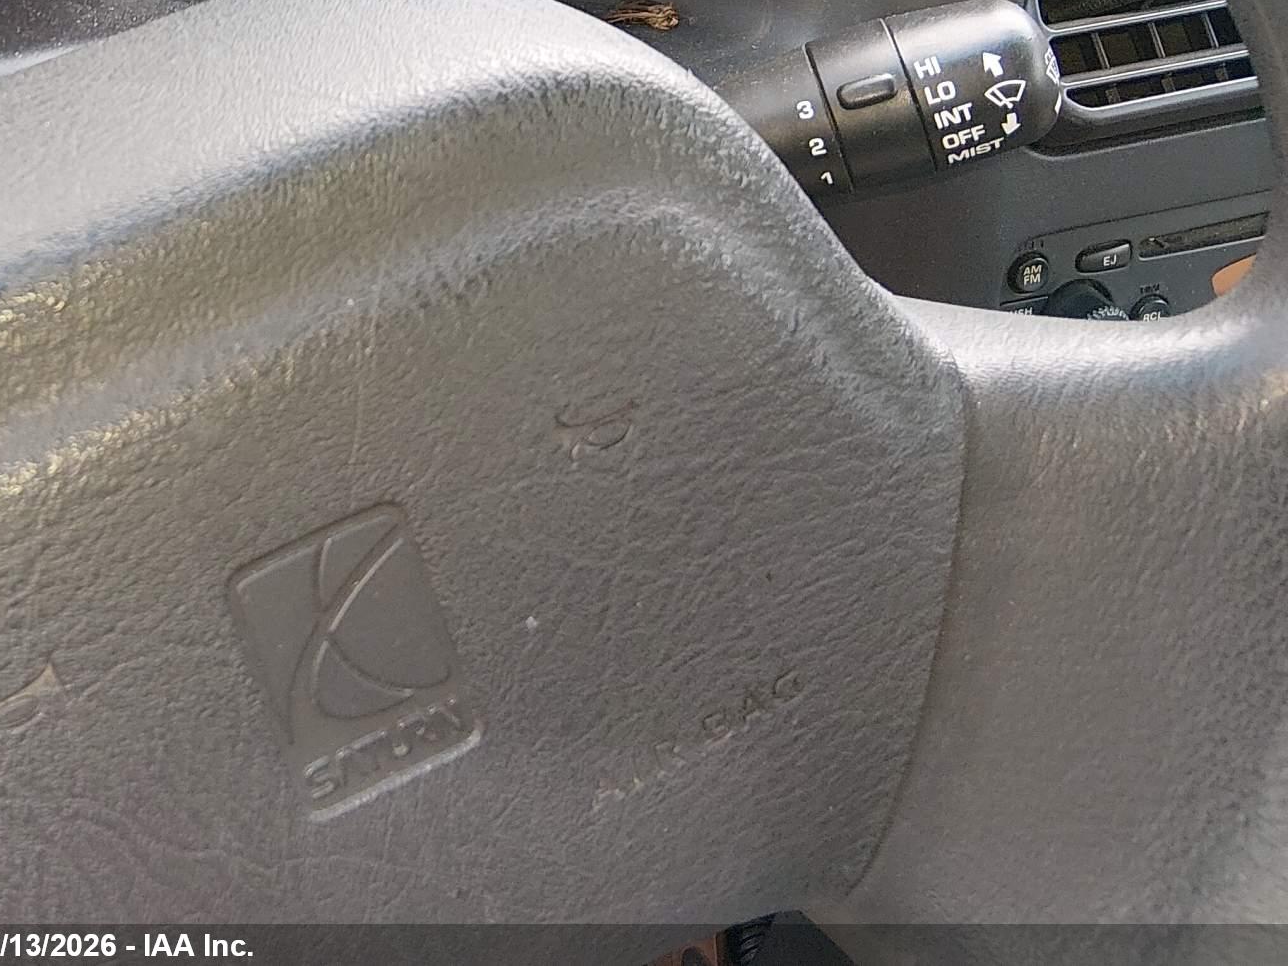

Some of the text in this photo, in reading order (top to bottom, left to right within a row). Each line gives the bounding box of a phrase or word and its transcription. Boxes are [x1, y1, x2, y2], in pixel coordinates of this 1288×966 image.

[914, 56, 941, 81] HI
[924, 81, 956, 106] LO
[796, 100, 815, 121] 3
[933, 101, 975, 130] INT
[808, 137, 827, 156] 2
[941, 125, 986, 150] OFF
[947, 136, 1005, 164] MIST
[819, 171, 833, 186] 1
[1023, 264, 1042, 276] AM
[1103, 255, 1117, 267] EJ
[1023, 273, 1041, 285] FM
